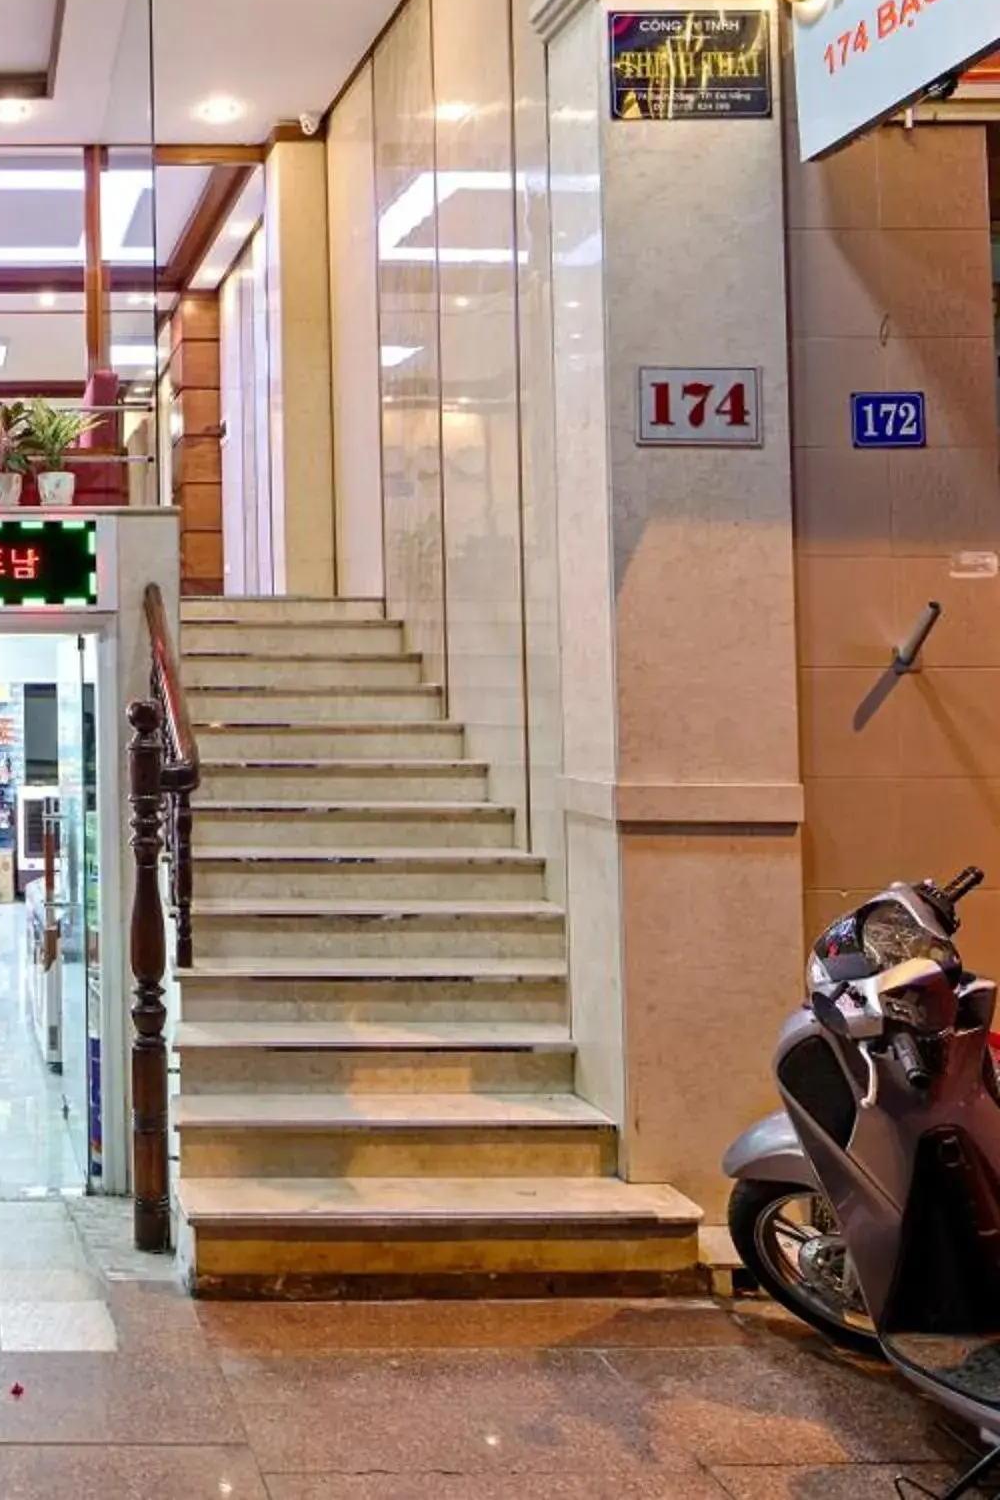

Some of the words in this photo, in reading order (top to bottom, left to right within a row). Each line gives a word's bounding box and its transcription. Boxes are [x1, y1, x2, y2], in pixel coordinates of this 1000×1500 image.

[823, 19, 870, 75] 174
[649, 382, 750, 428] 174
[862, 402, 918, 438] 172
